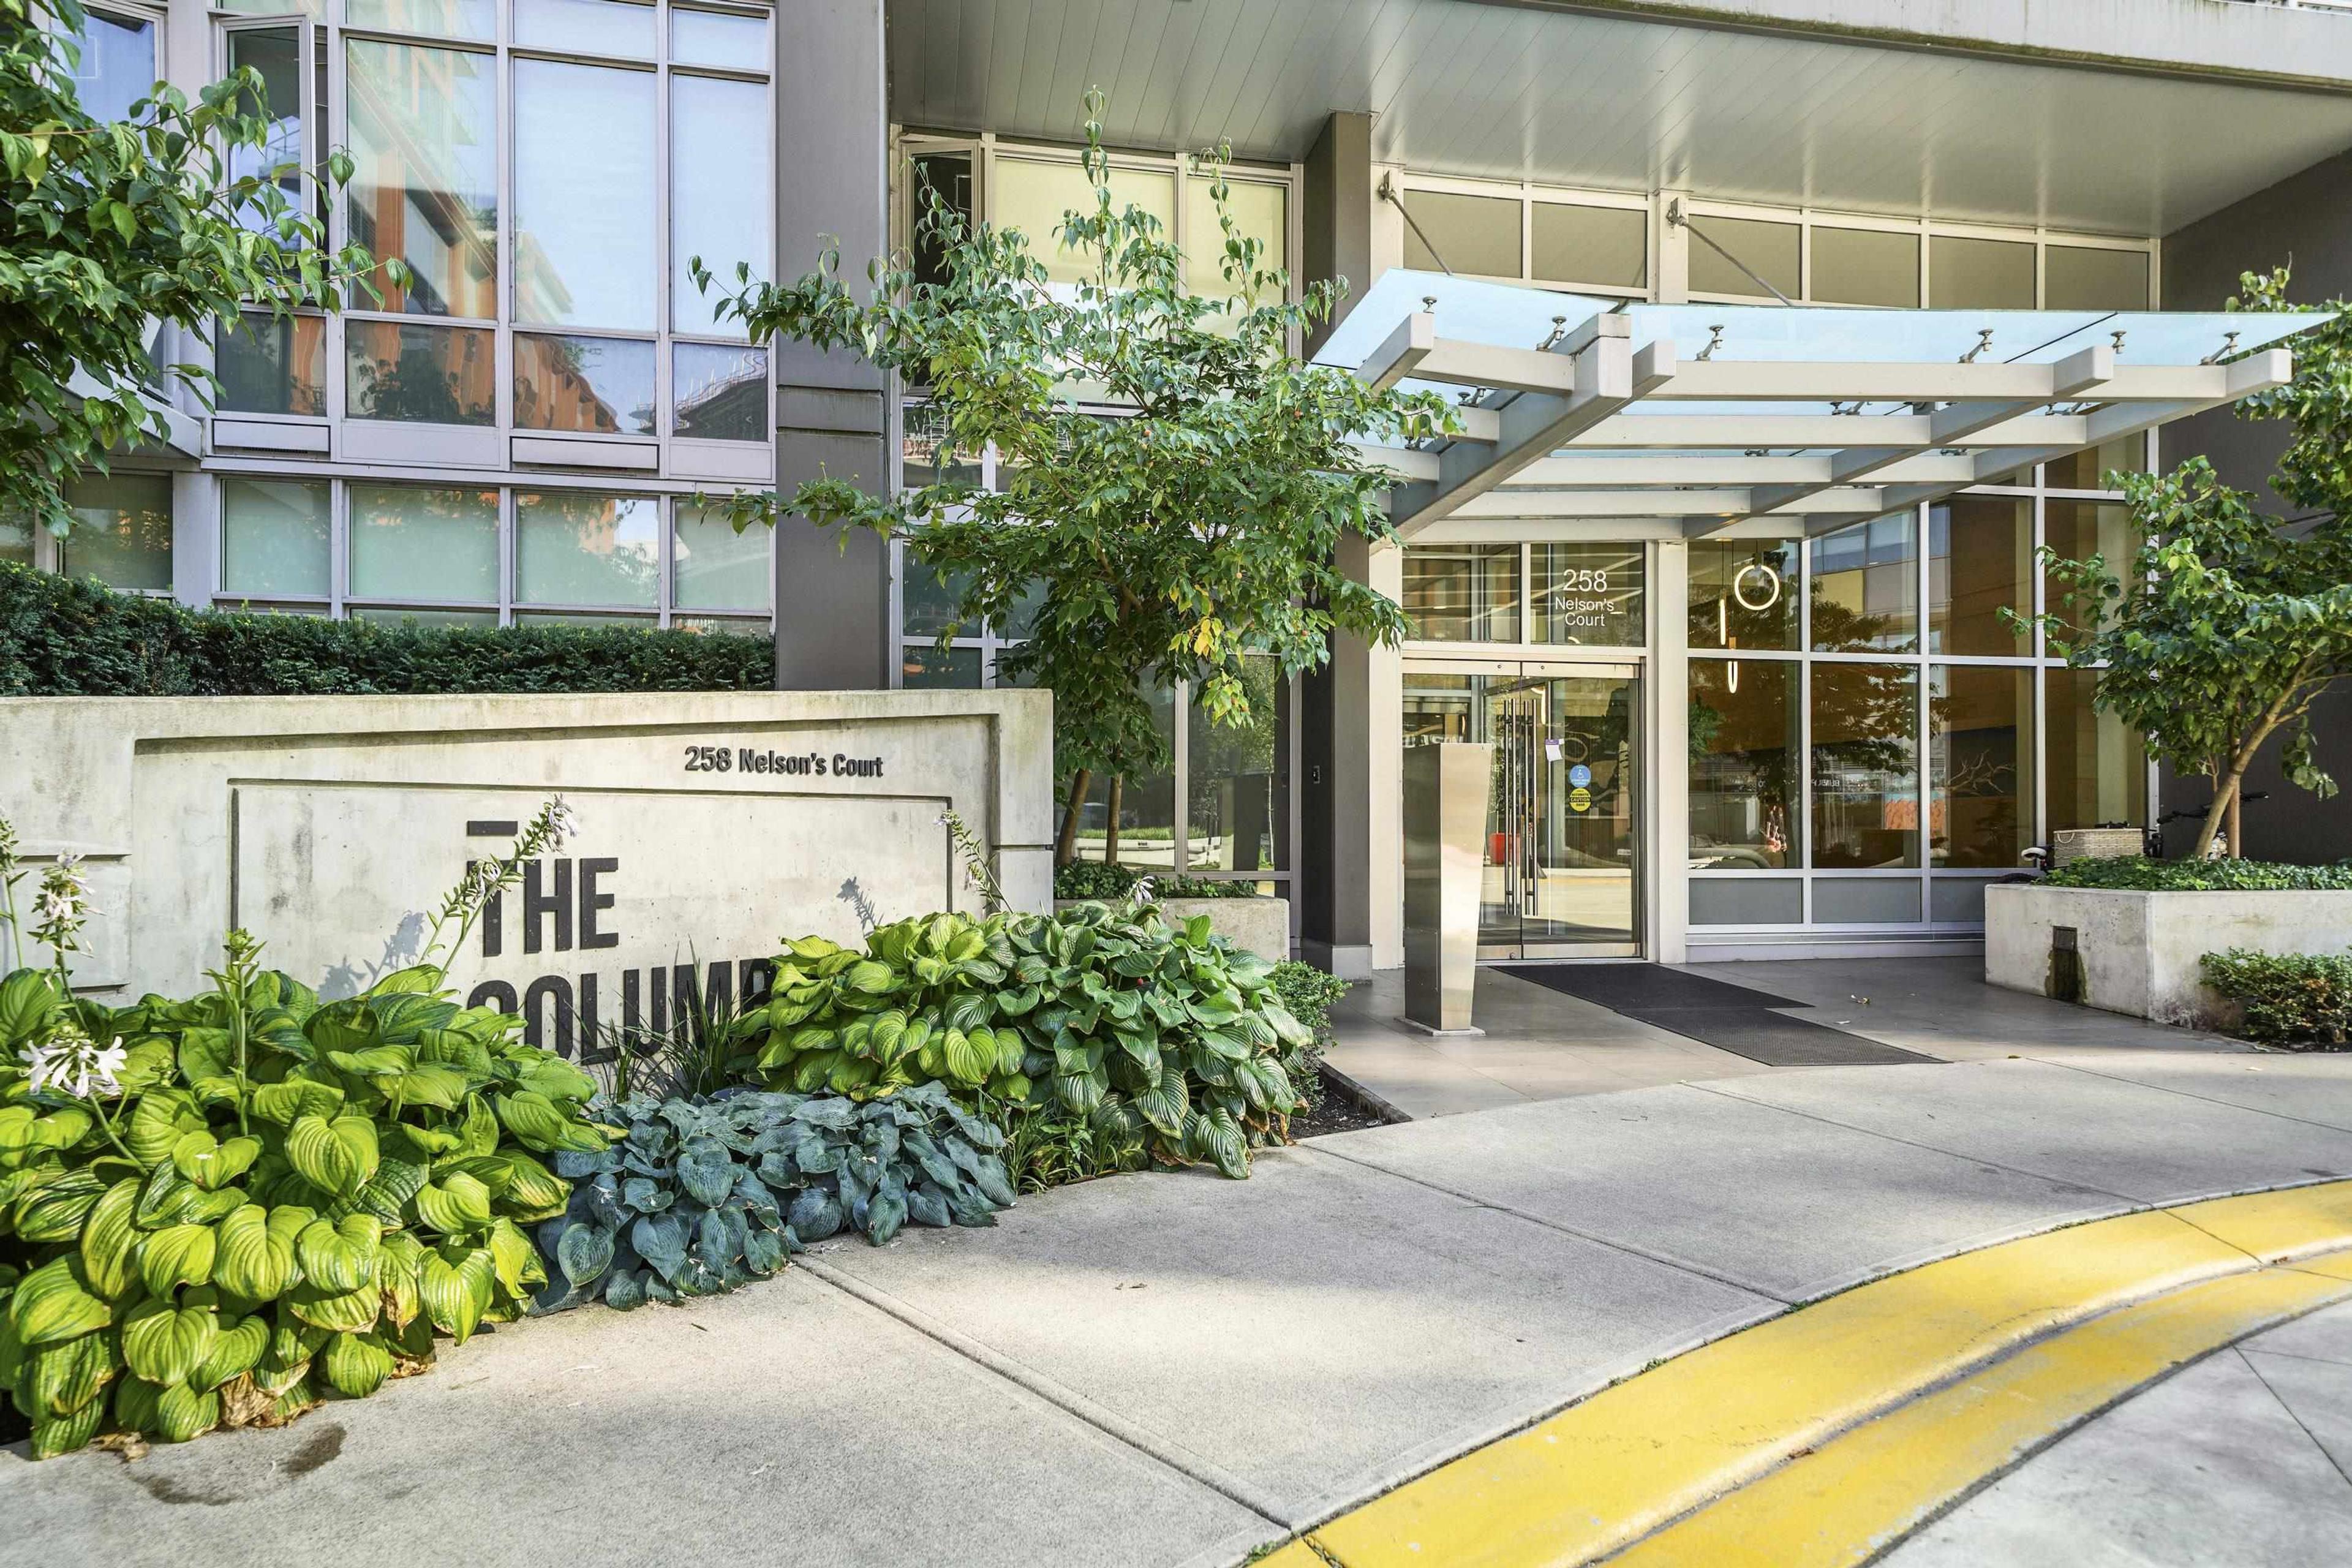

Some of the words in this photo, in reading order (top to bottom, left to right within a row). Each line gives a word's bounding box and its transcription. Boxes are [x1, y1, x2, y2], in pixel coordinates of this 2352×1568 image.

[1563, 569, 1607, 592] 258
[1555, 597, 1615, 611] Nelson's
[1565, 612, 1605, 627] Court
[685, 746, 732, 772] 258
[739, 748, 827, 775] Nelson's
[833, 753, 883, 777] Court
[467, 858, 618, 957] THE
